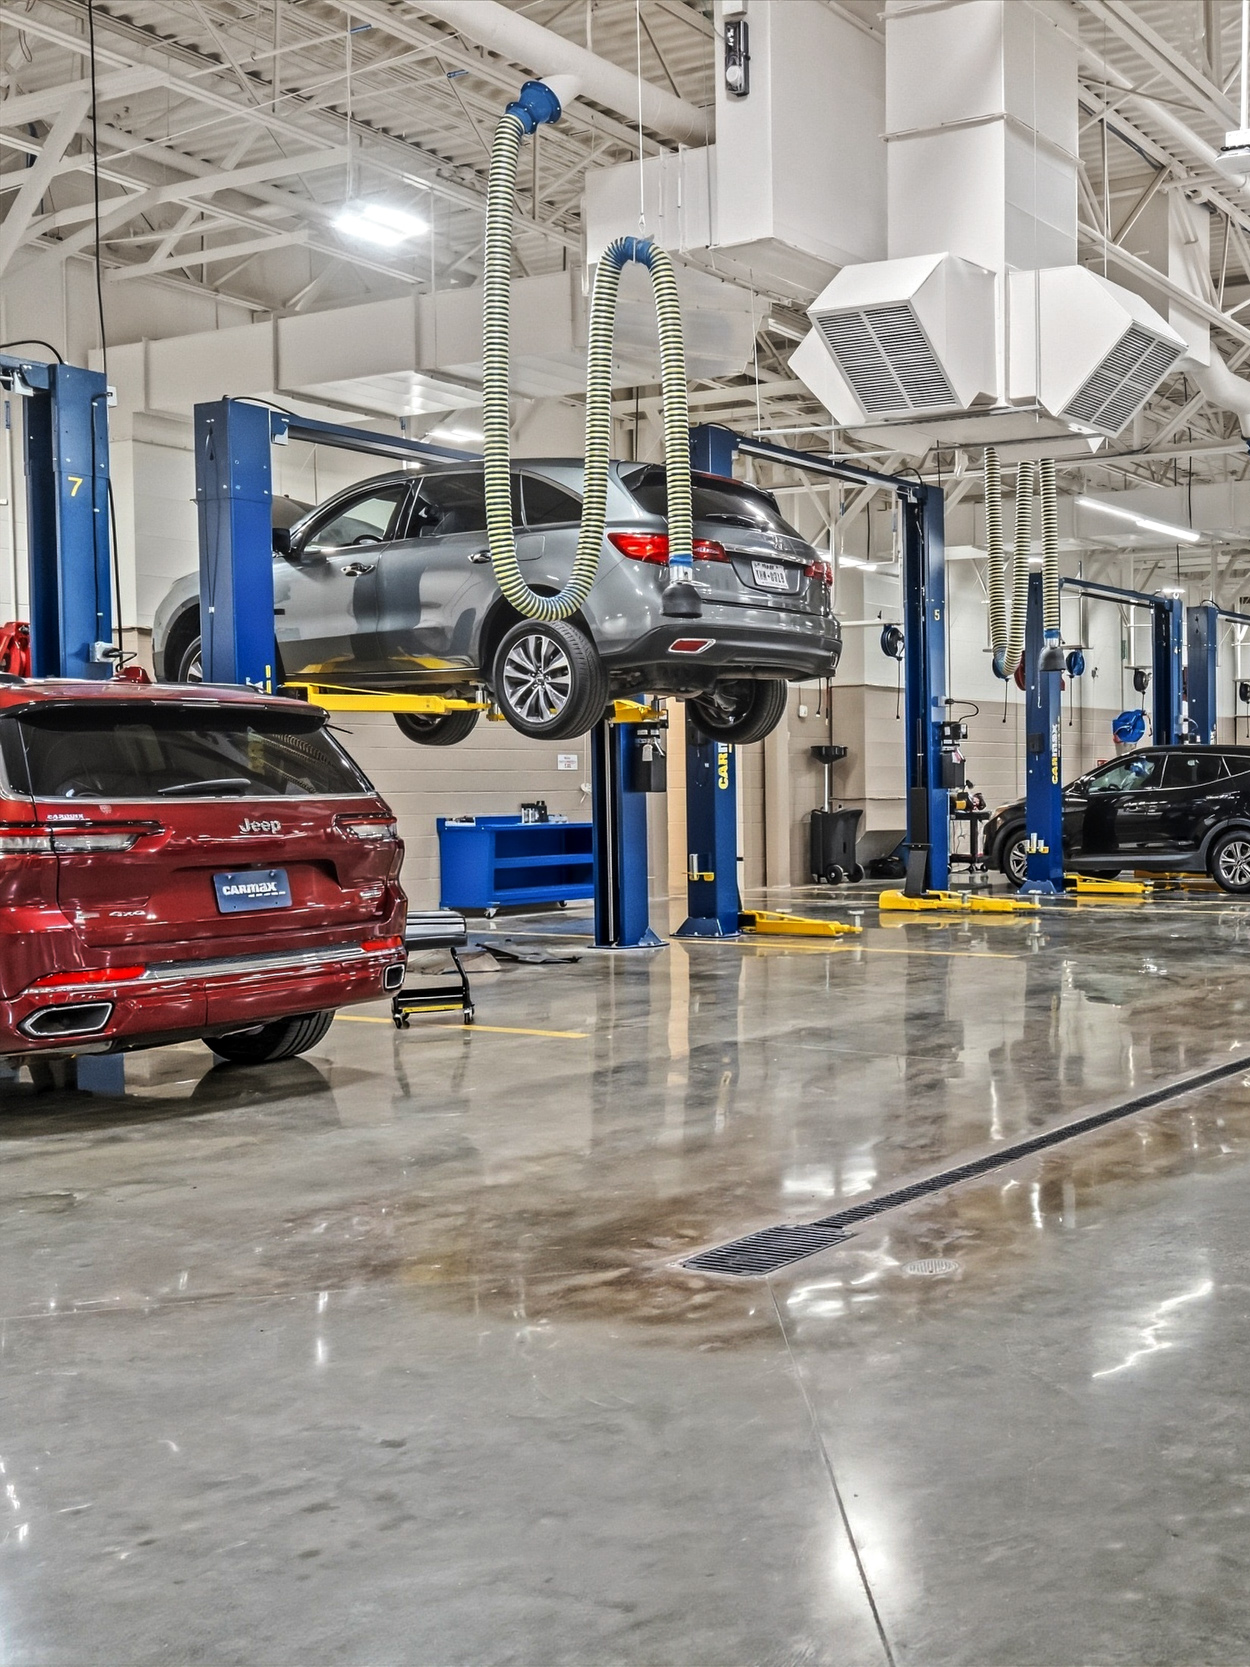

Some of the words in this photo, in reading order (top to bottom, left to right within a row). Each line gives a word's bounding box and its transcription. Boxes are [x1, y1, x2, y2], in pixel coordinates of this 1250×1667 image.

[68, 476, 83, 497] 7
[934, 609, 940, 621] 5
[239, 818, 282, 834] Jeep
